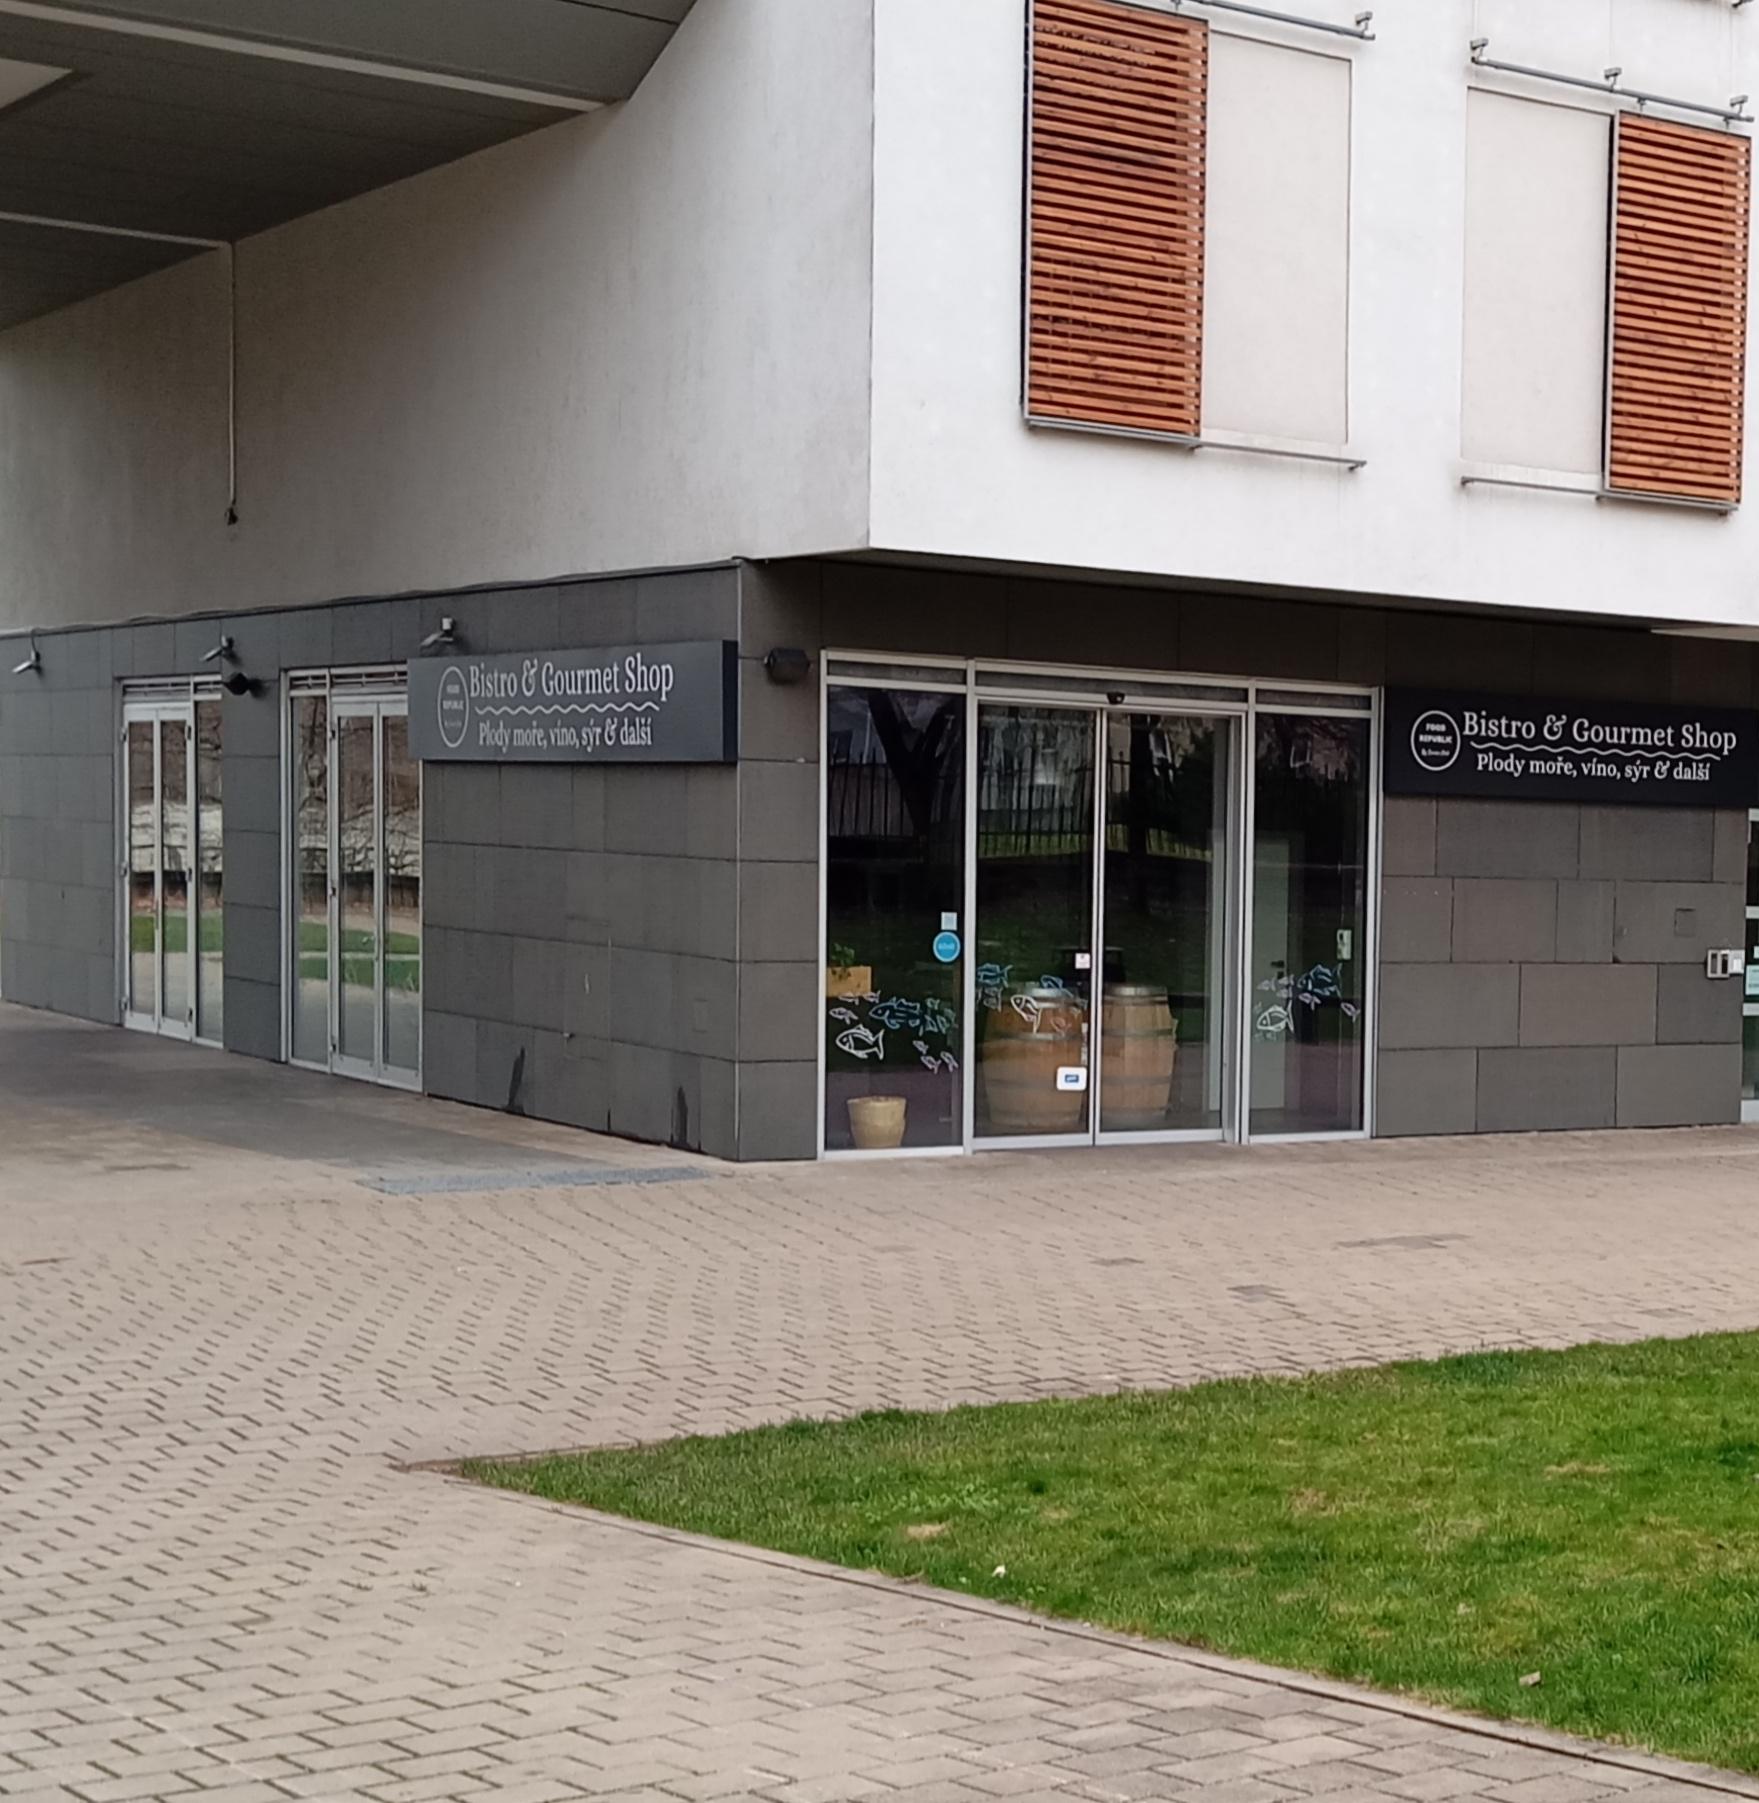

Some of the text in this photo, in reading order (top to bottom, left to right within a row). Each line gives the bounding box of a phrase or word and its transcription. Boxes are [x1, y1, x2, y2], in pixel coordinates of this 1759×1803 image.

[469, 651, 674, 702] Bistro & Gourmet Shop
[479, 719, 511, 754] Plody
[549, 718, 580, 750] víno,
[581, 717, 602, 753] sýr
[604, 716, 618, 747] &
[620, 716, 652, 746] další
[1462, 709, 1737, 756] Bistro & Gourmet Shop
[1477, 751, 1711, 783] Plody moře, víno, sýr & další
